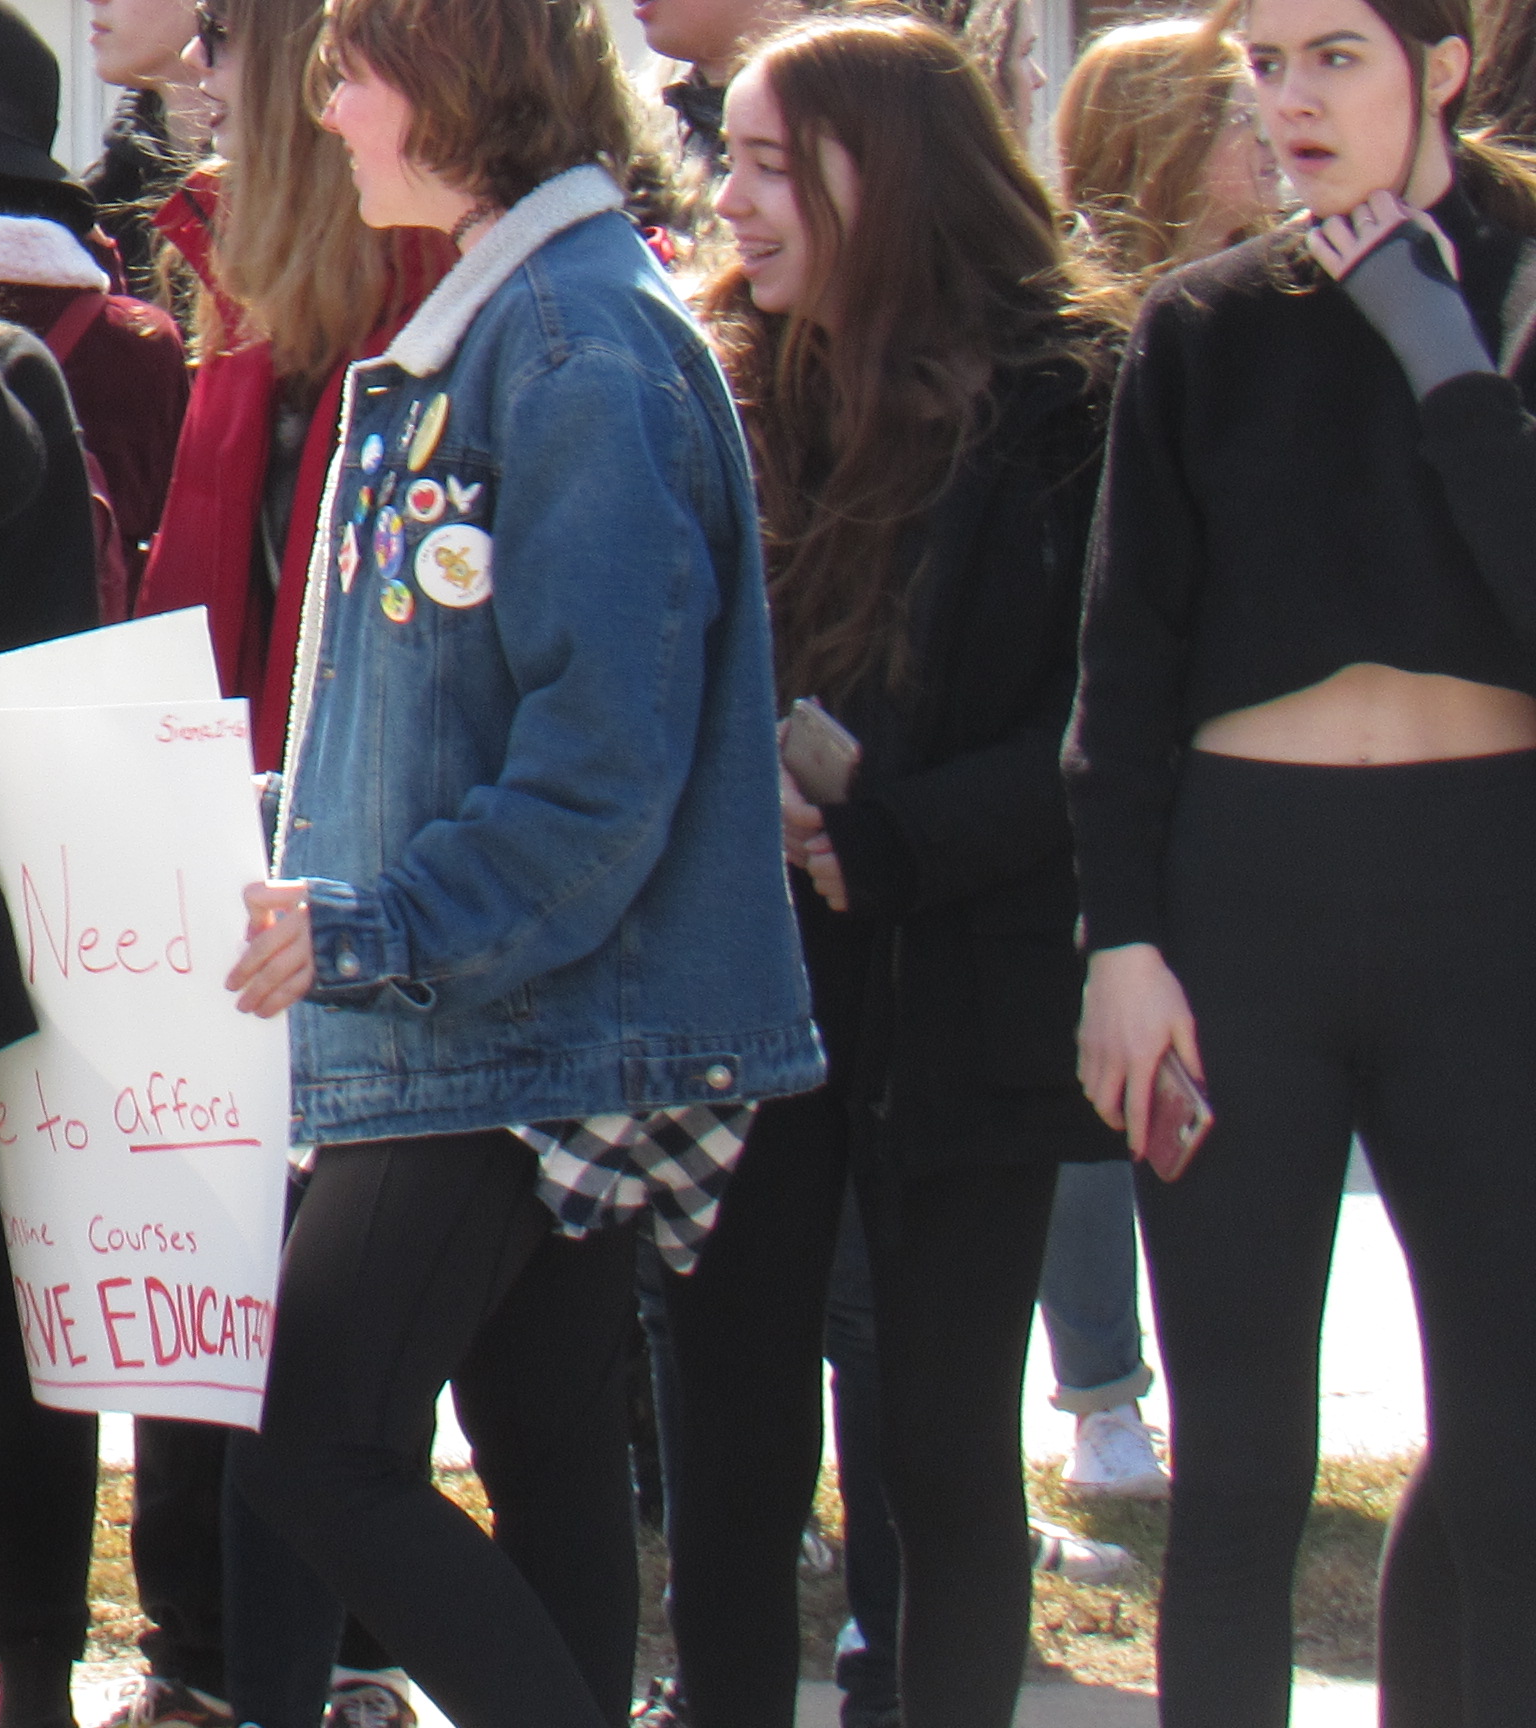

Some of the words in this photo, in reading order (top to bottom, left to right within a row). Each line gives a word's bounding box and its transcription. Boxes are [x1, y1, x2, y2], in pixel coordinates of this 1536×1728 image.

[21, 845, 193, 985] Need
[35, 1069, 89, 1152] to
[113, 1071, 241, 1136] afford
[88, 1214, 198, 1255] Courses
